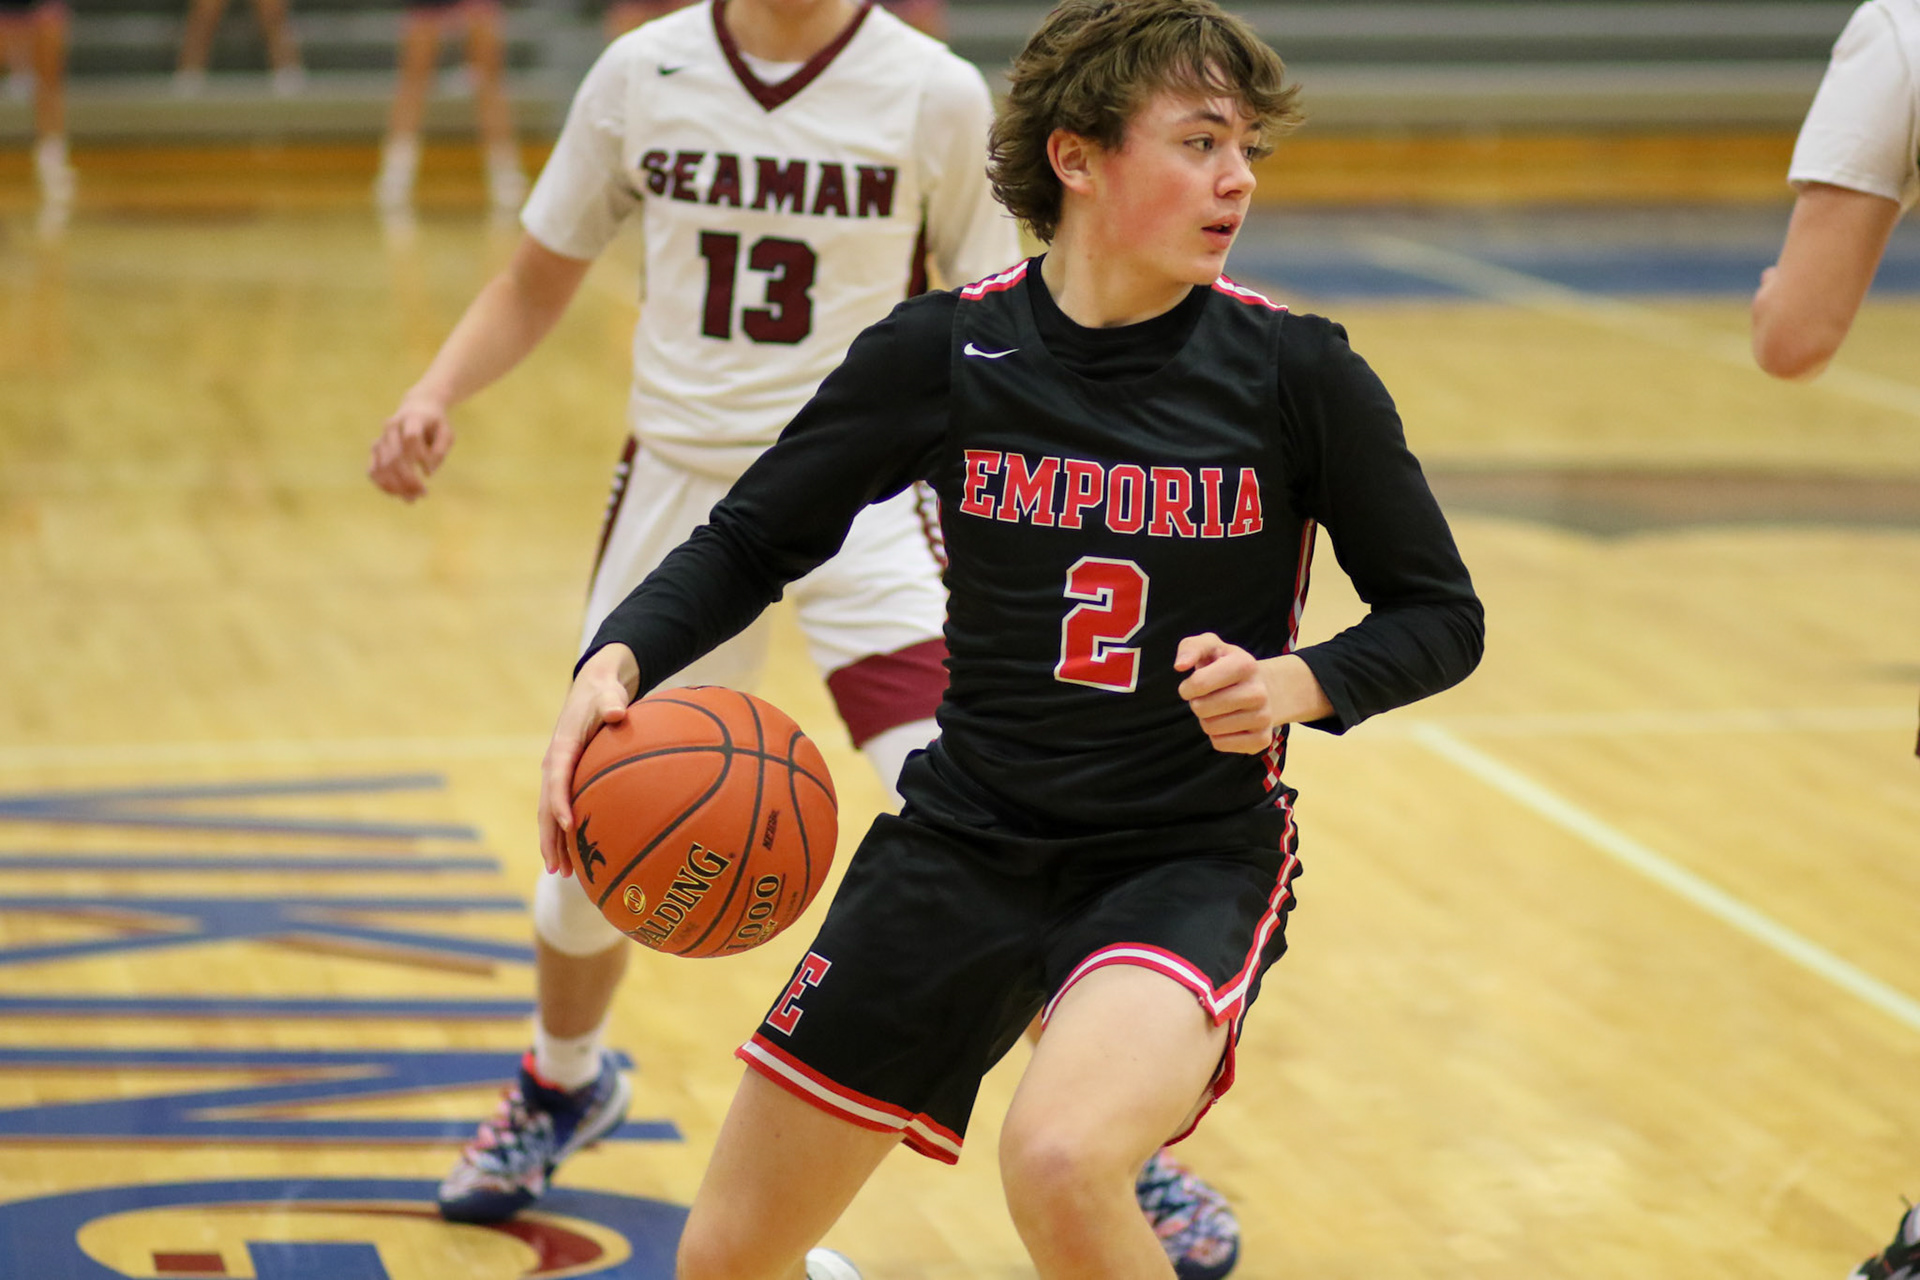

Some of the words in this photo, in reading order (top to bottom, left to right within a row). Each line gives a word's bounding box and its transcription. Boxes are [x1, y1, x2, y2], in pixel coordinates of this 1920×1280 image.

[640, 149, 898, 218] SEAMAN
[697, 229, 817, 345] 13
[959, 449, 1264, 539] EMPORIA
[1053, 555, 1150, 693] 2
[766, 951, 832, 1037] E
